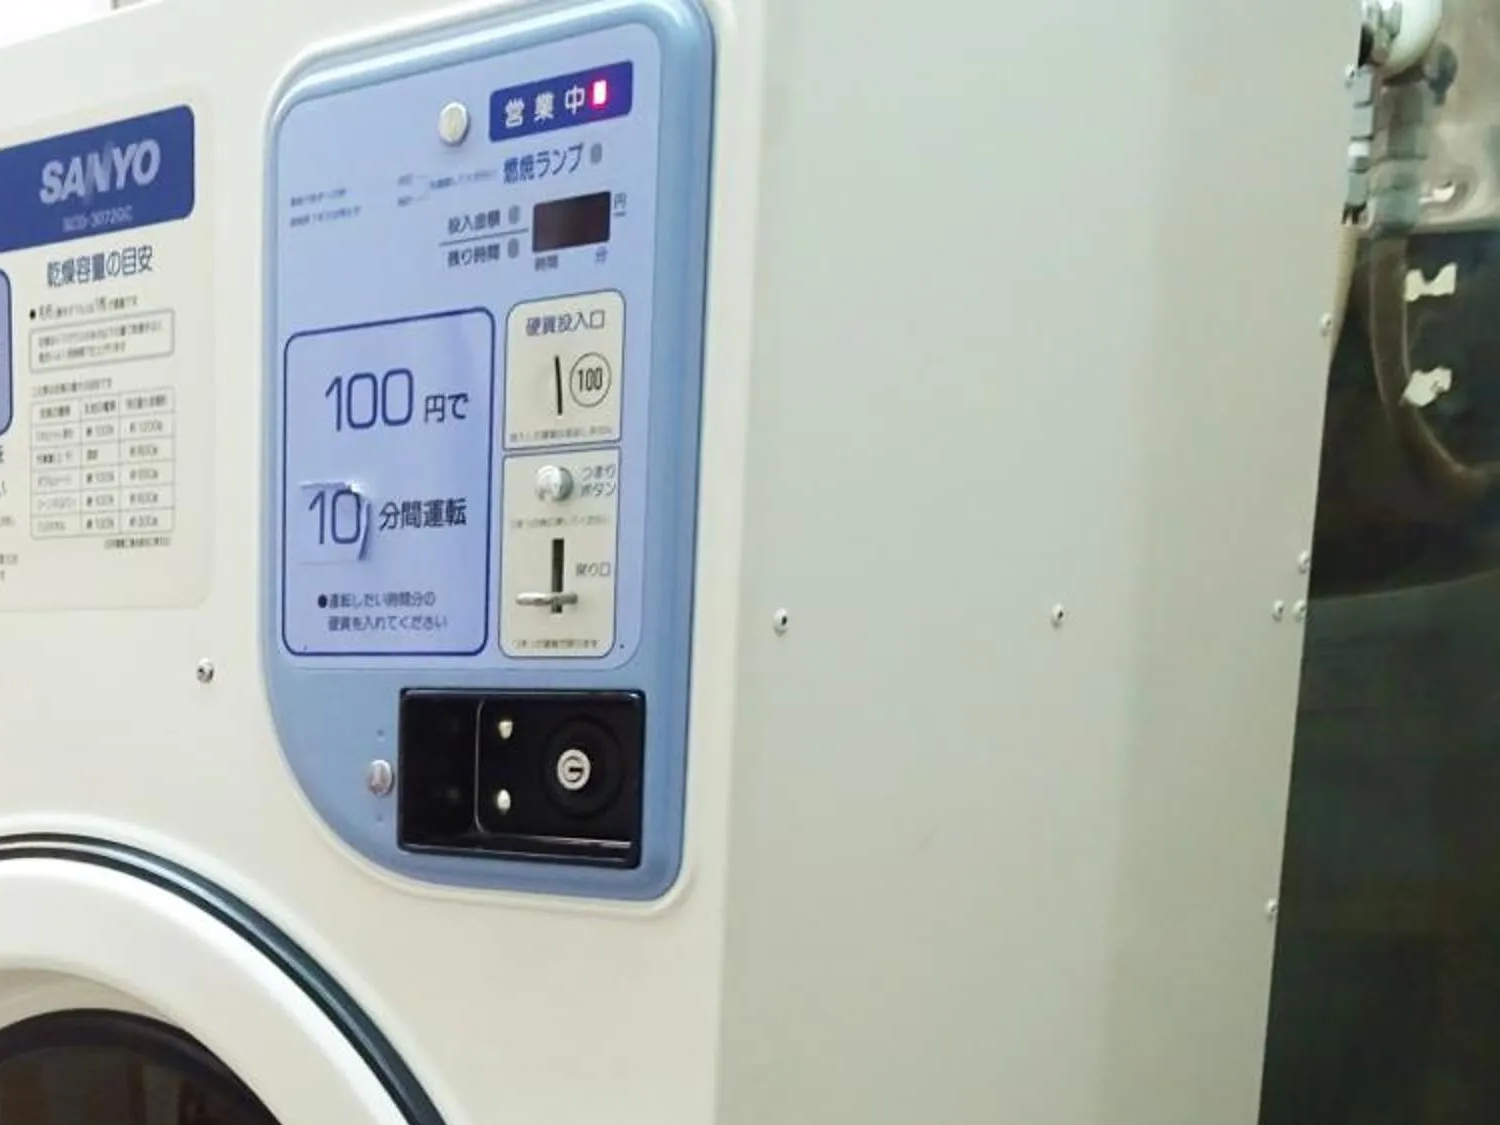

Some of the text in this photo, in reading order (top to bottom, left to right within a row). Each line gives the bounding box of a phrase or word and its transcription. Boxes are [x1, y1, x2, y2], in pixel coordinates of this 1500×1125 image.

[505, 84, 585, 128] 営業中
[40, 139, 161, 204] SANYO
[503, 142, 584, 183] 燃焼ランプ
[47, 245, 153, 288] 乾燥容量の目安
[448, 244, 500, 267] 残り時間
[526, 309, 605, 336] 硬貨投入口
[578, 367, 603, 392] 100
